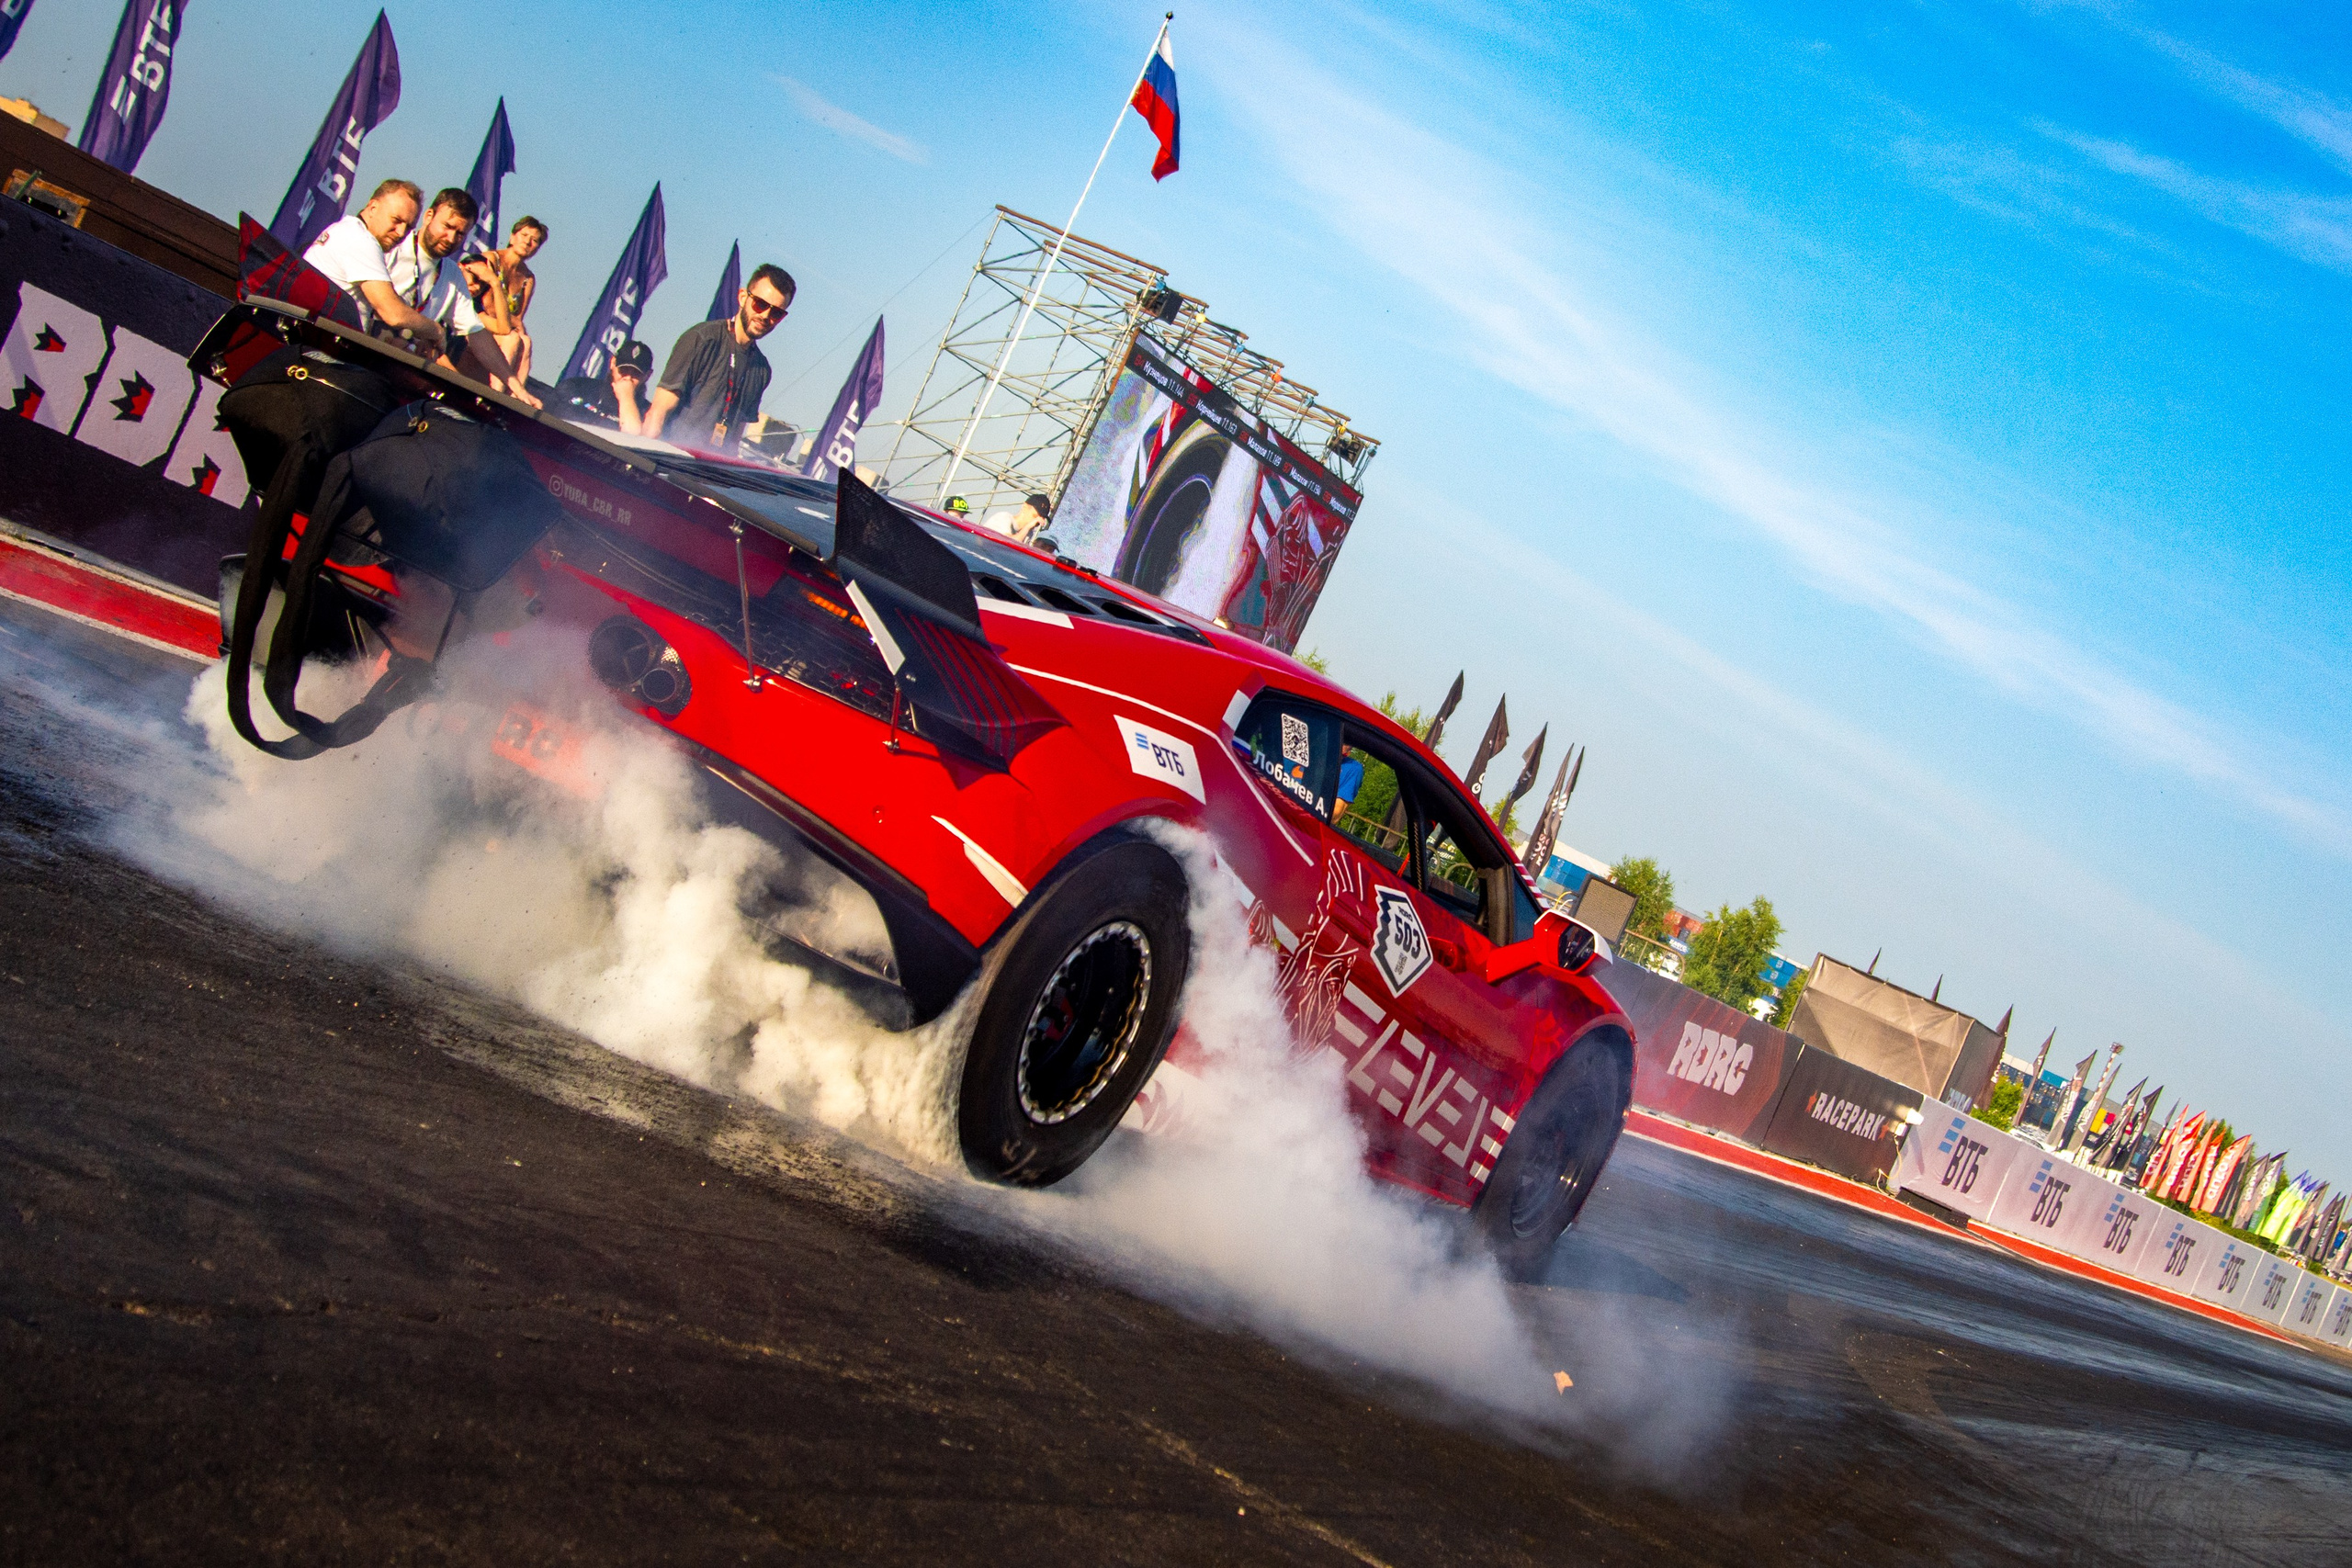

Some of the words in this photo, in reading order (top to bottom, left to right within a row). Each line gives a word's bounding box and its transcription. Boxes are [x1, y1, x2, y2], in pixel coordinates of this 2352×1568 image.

[0, 280, 252, 509] RDR
[1152, 742, 1185, 779] ВТБ
[1253, 750, 1314, 805] Лобачев
[1394, 916, 1421, 958] 503
[1667, 1021, 1754, 1096] RDRC
[1811, 1092, 1886, 1142] RACEPARK
[1940, 1135, 1989, 1194] ВТБ
[2030, 1177, 2071, 1228] ВТБ
[2103, 1207, 2139, 1255] ВТБ
[2165, 1235, 2196, 1277] ВТБ
